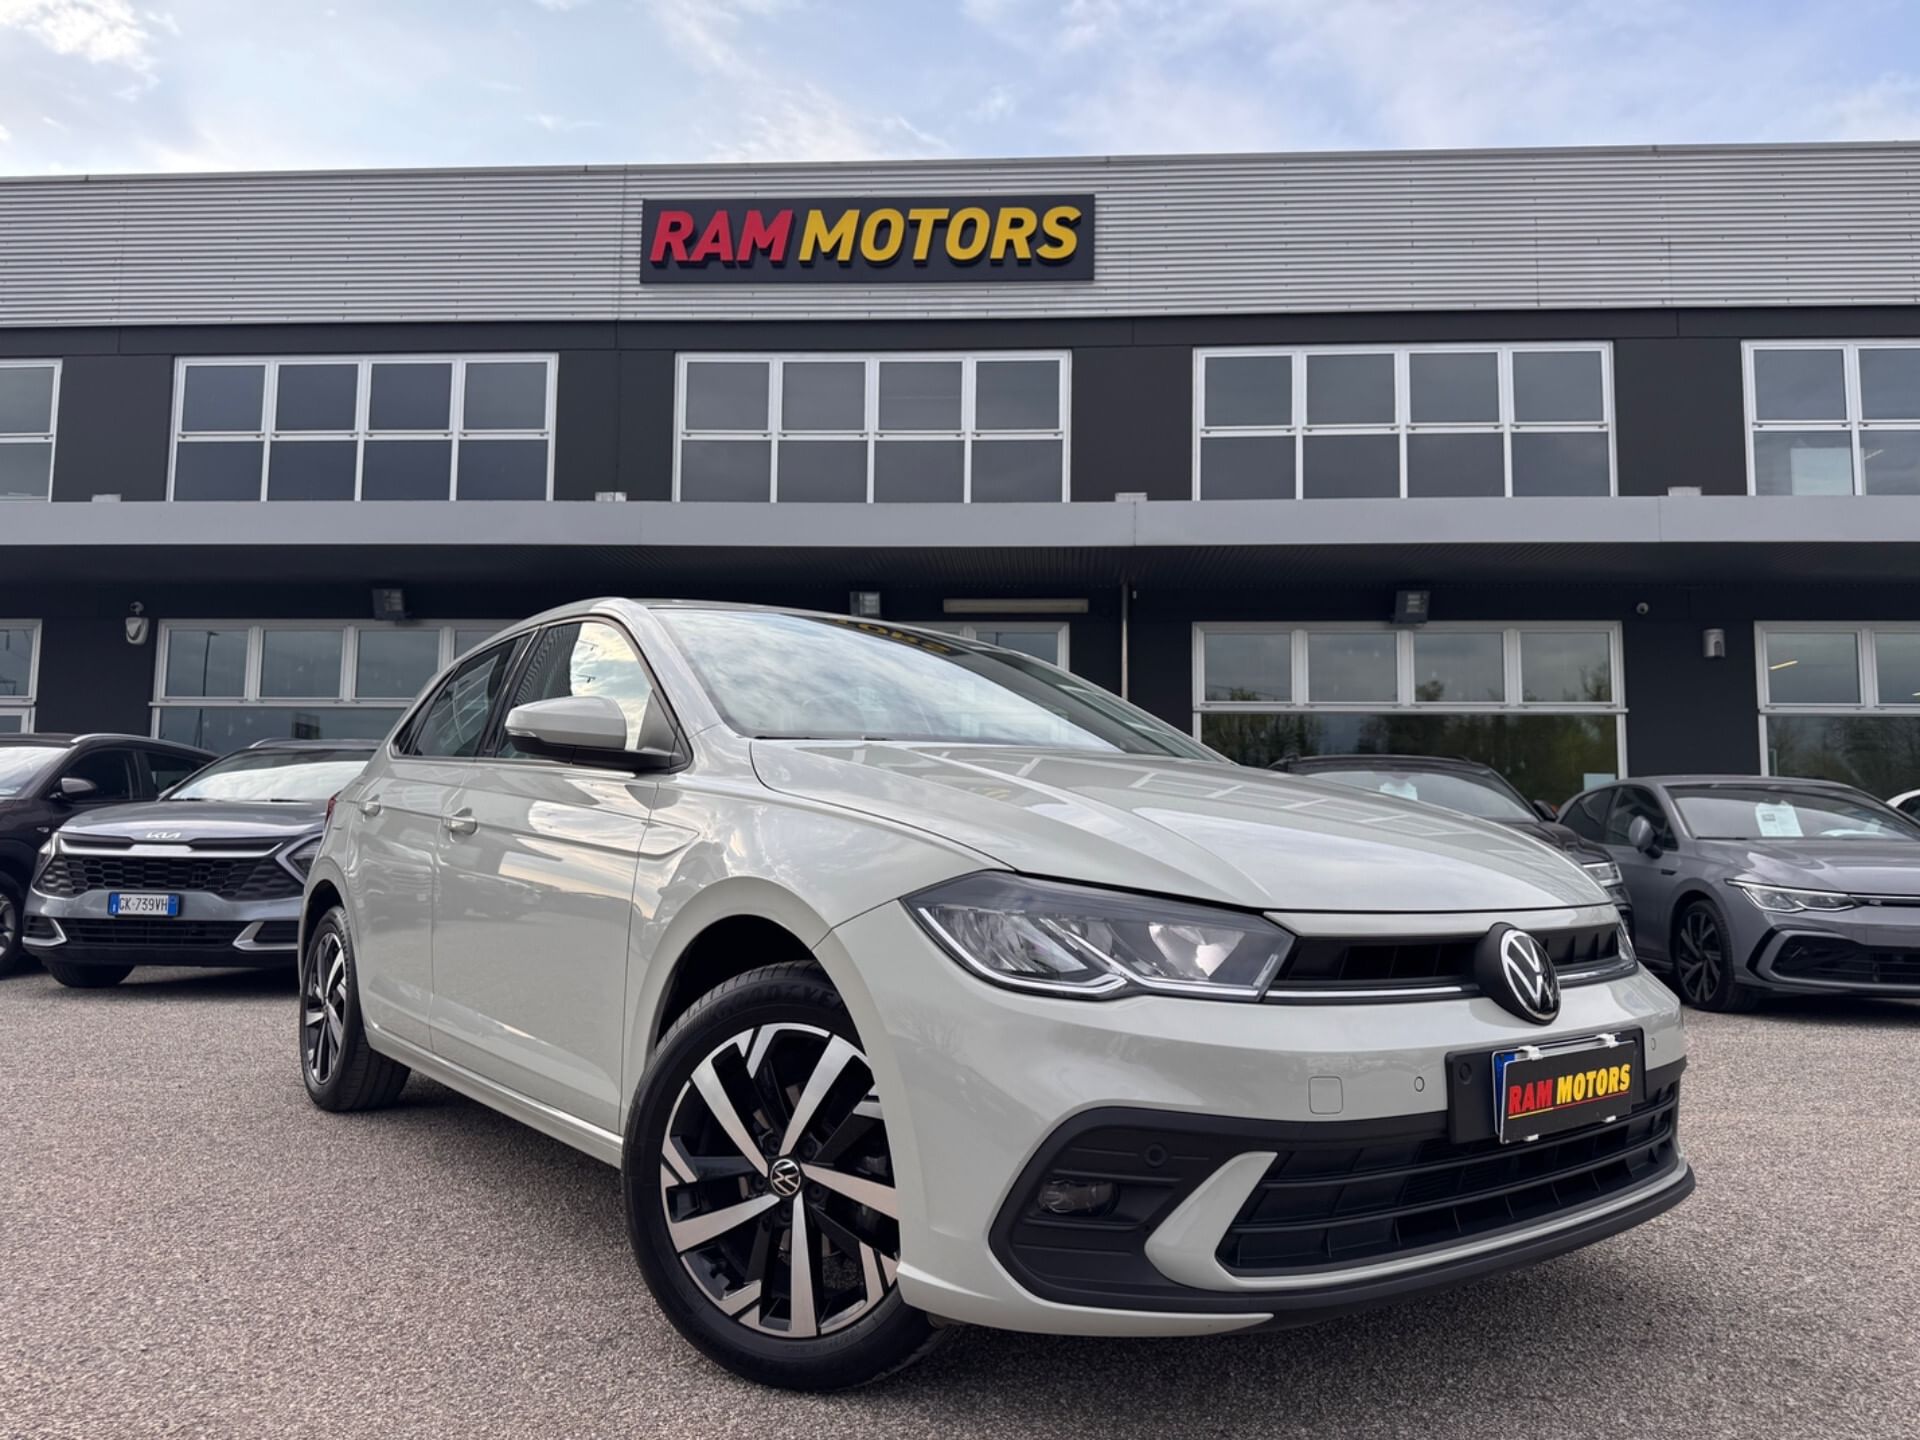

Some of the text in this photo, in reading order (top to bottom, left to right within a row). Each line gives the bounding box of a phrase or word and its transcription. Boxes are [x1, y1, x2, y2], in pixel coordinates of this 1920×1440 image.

[650, 206, 1082, 263] RAM MOTORS
[1508, 1063, 1632, 1114] RAM MOTORS
